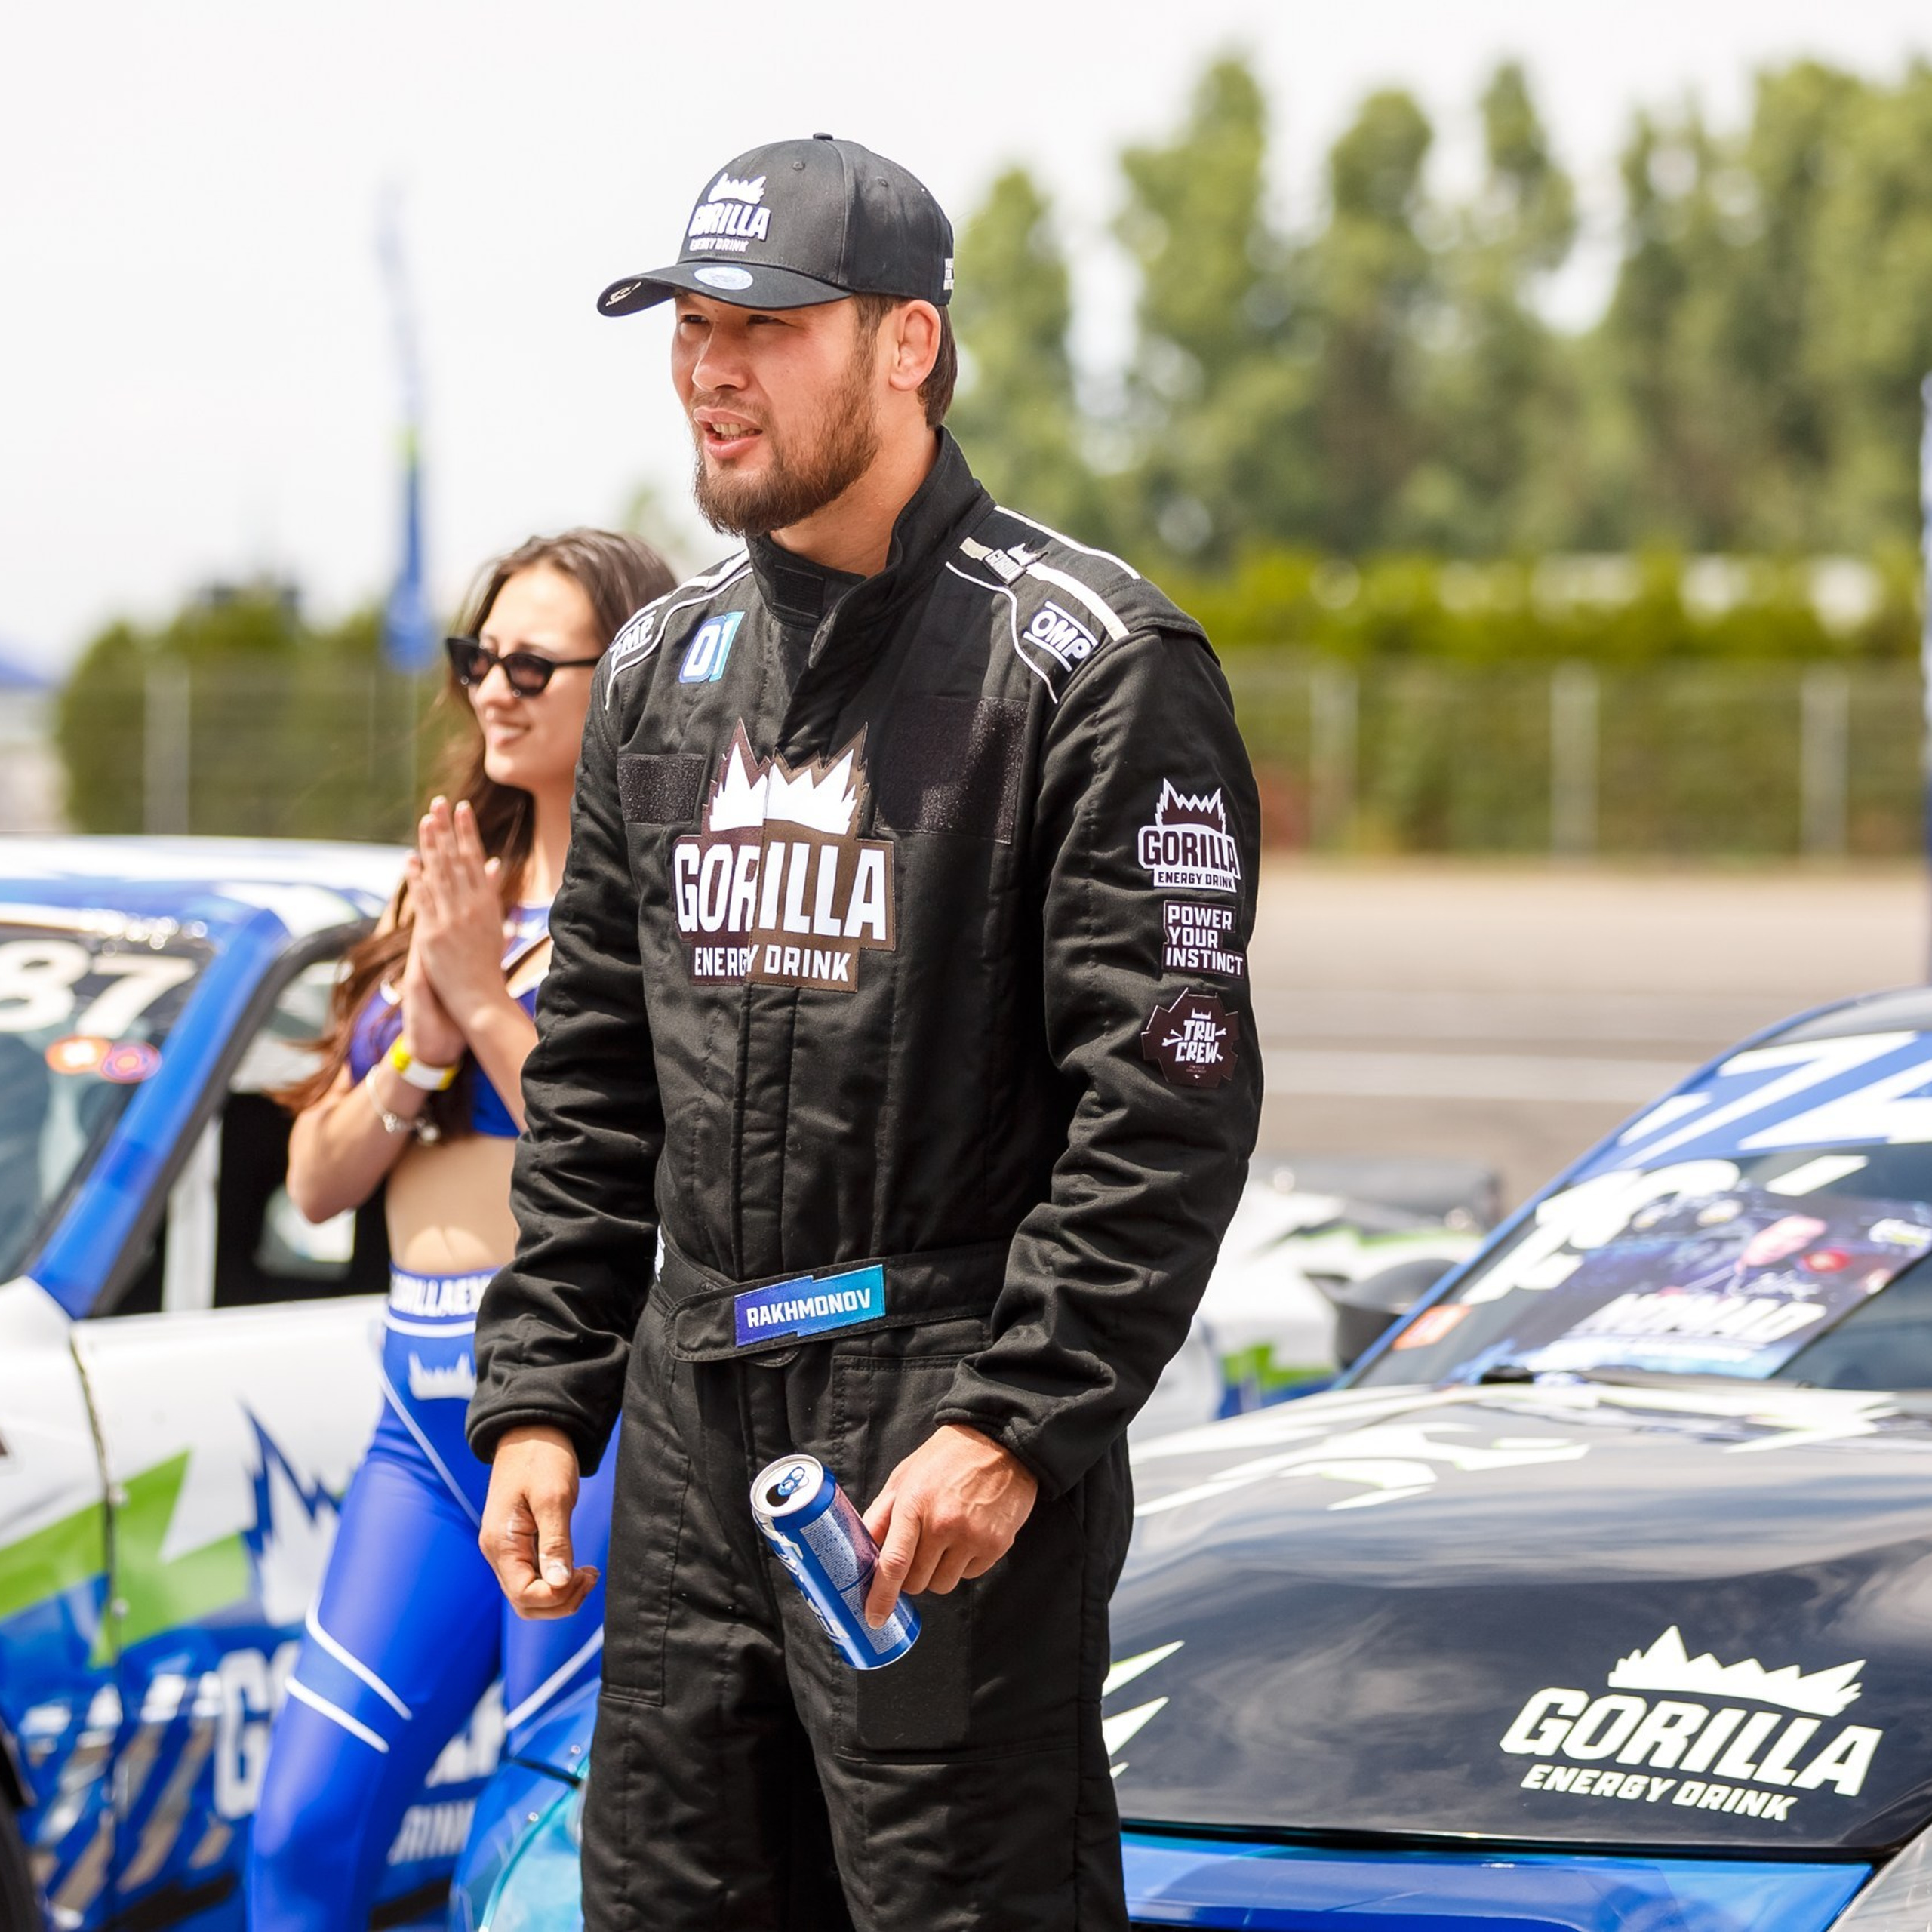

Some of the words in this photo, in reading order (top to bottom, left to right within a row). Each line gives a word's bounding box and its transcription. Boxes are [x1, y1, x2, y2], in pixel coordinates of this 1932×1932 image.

[714, 238, 749, 253] DRINK
[1030, 608, 1092, 661] OMP
[1143, 829, 1239, 878] GORILLA
[674, 841, 889, 941] GORILLA
[1158, 871, 1203, 885] ENERGY
[1205, 874, 1235, 890] DRINK
[1167, 905, 1233, 931] POWER
[1168, 925, 1218, 949] YOUR
[694, 944, 760, 977] ENERGY
[763, 943, 852, 983] DRINK
[1165, 947, 1244, 976] INSTINCT
[1183, 1019, 1217, 1042] TRU
[1174, 1041, 1220, 1064] CREW
[746, 1287, 871, 1328] RAKHMONOV
[1499, 1687, 1884, 1797] GORILLA
[1520, 1764, 1678, 1803] ENERGY
[1671, 1780, 1799, 1823] DRINK
